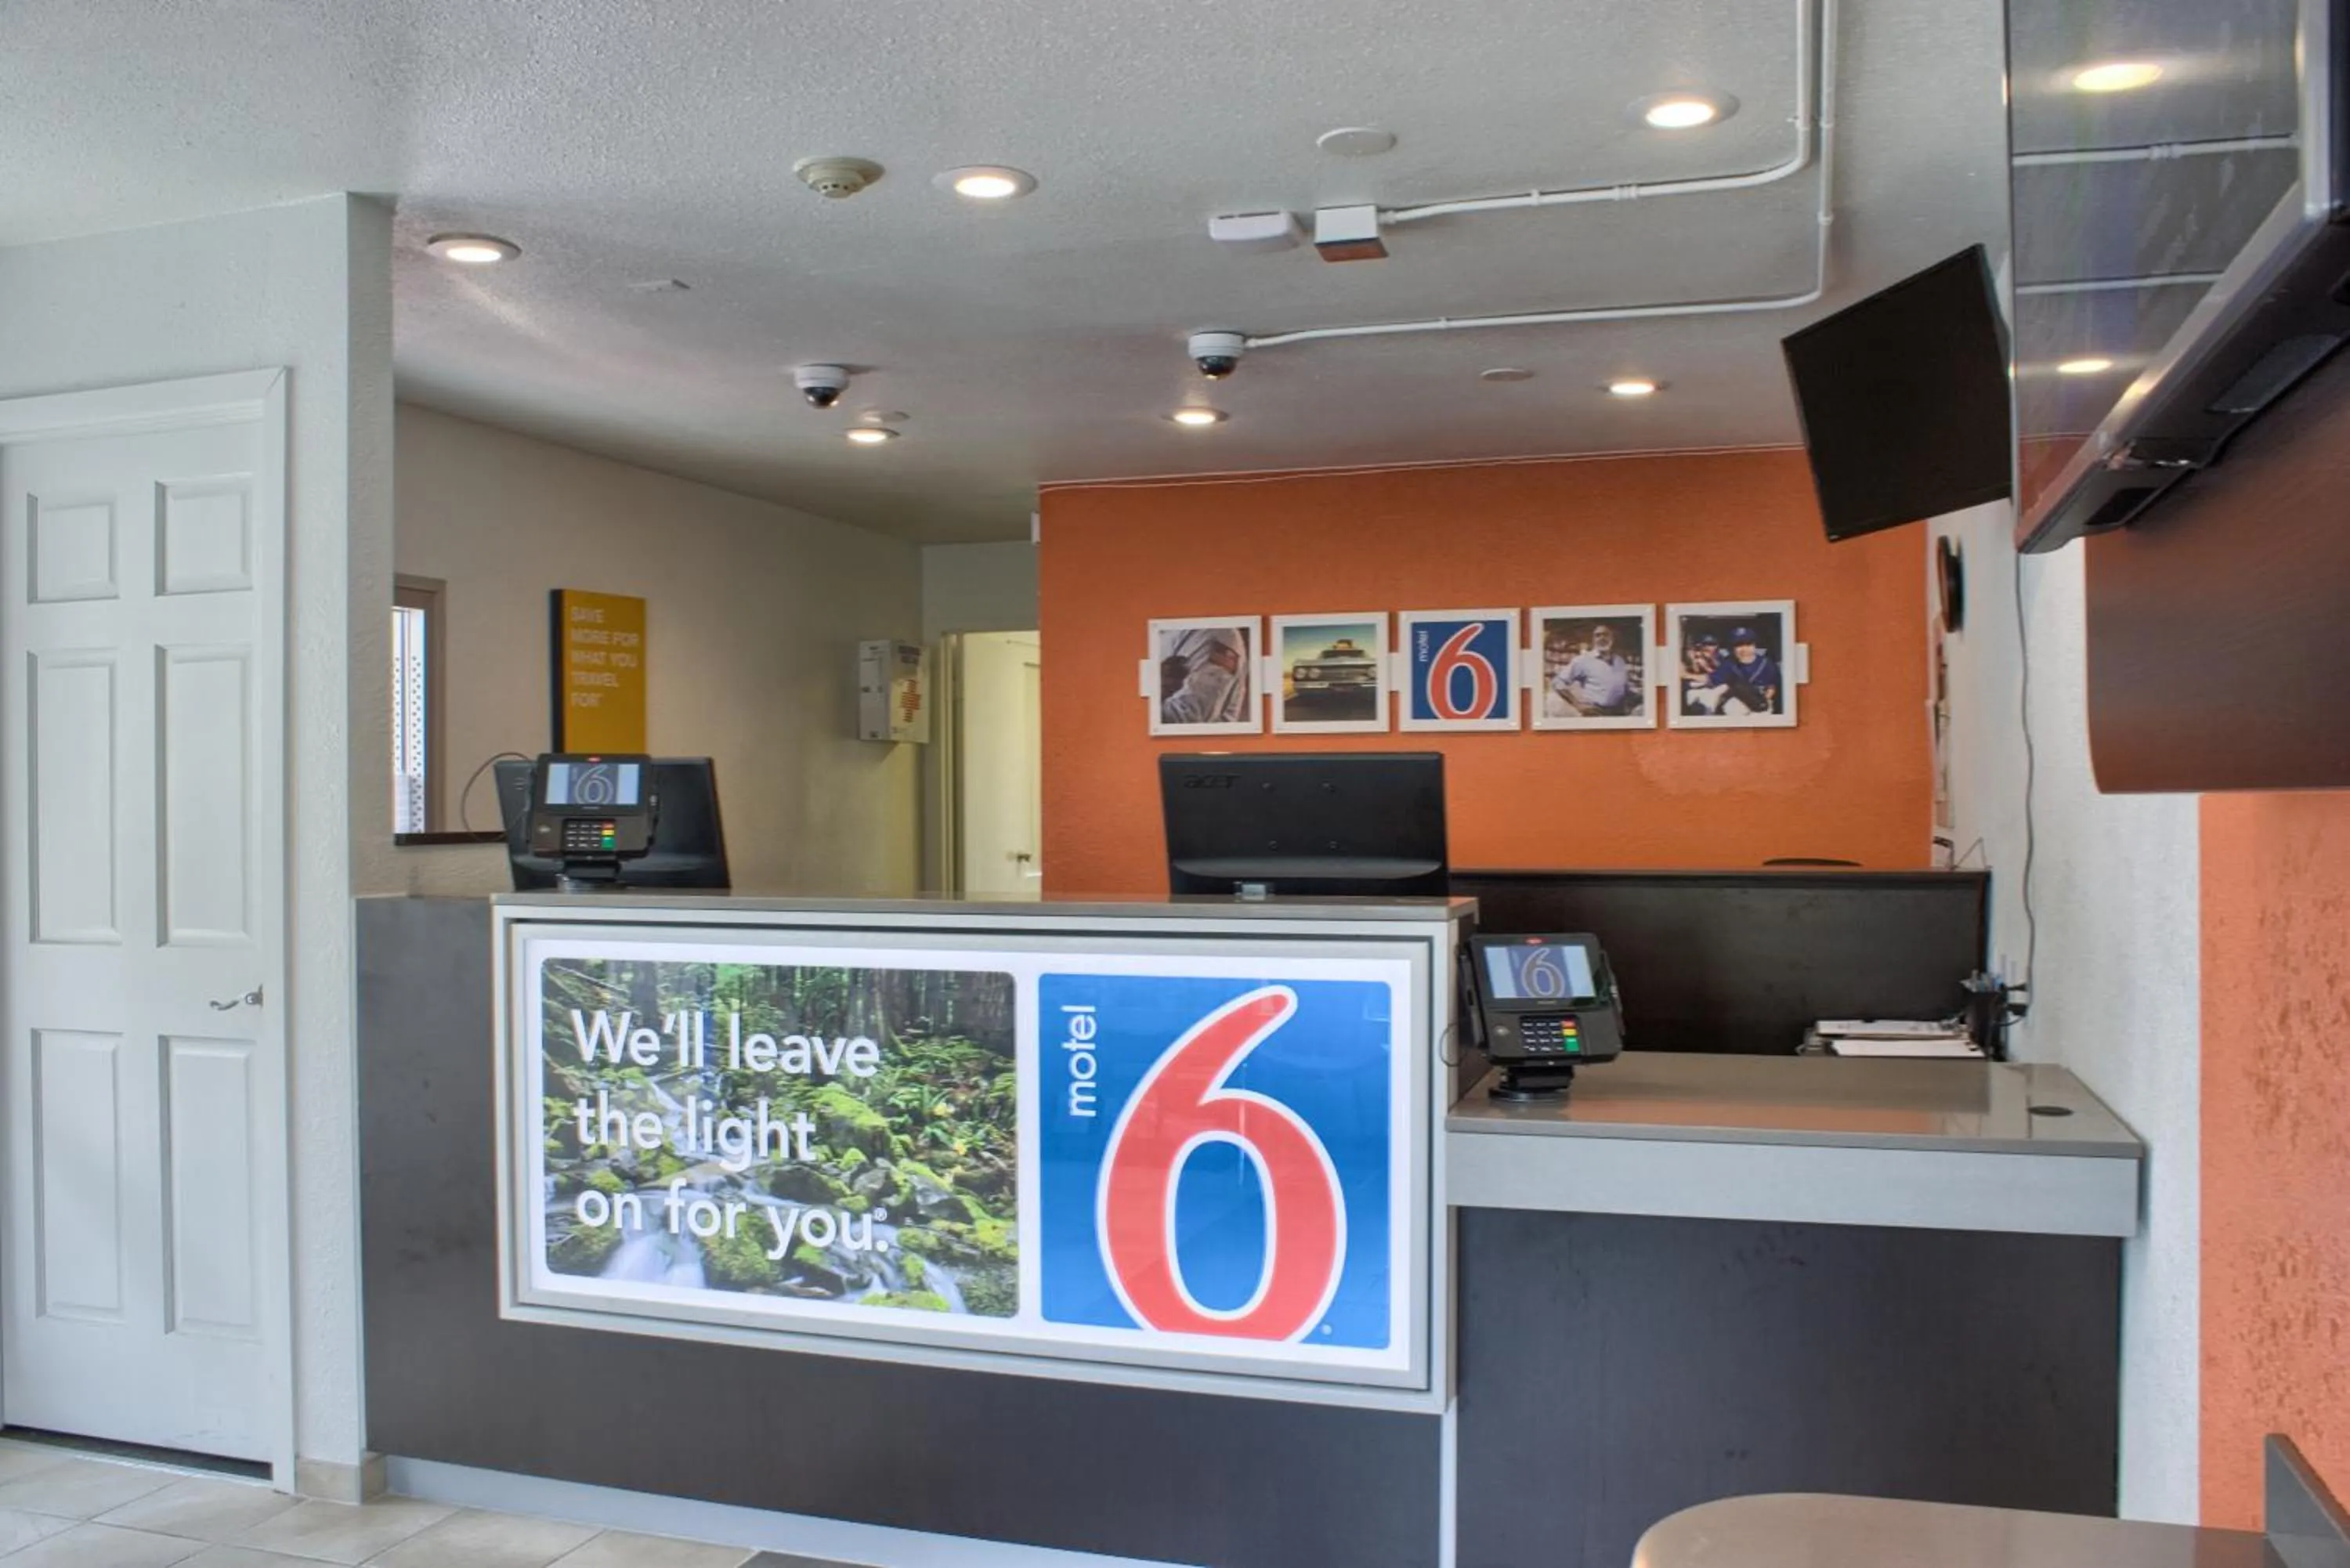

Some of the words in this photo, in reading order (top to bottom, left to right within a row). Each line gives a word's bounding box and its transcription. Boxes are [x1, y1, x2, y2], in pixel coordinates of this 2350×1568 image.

[571, 606, 605, 623] SAVE
[571, 627, 609, 645] MORE
[611, 631, 639, 648] FOR
[571, 649, 606, 666] WHAT
[609, 652, 639, 669] YOU
[1417, 630, 1429, 663] motel
[571, 670, 620, 688] TRAVEL
[1426, 623, 1498, 720] 6
[575, 764, 614, 804] 6
[1183, 773, 1242, 789] acer
[1520, 947, 1565, 999] 6
[570, 1009, 704, 1069] We'll
[729, 1012, 880, 1078] leave
[1061, 1005, 1097, 1118] motel
[573, 1089, 663, 1150] the
[686, 1095, 817, 1172] light
[1094, 985, 1347, 1343] 6
[576, 1189, 643, 1231] on
[663, 1178, 747, 1240] for
